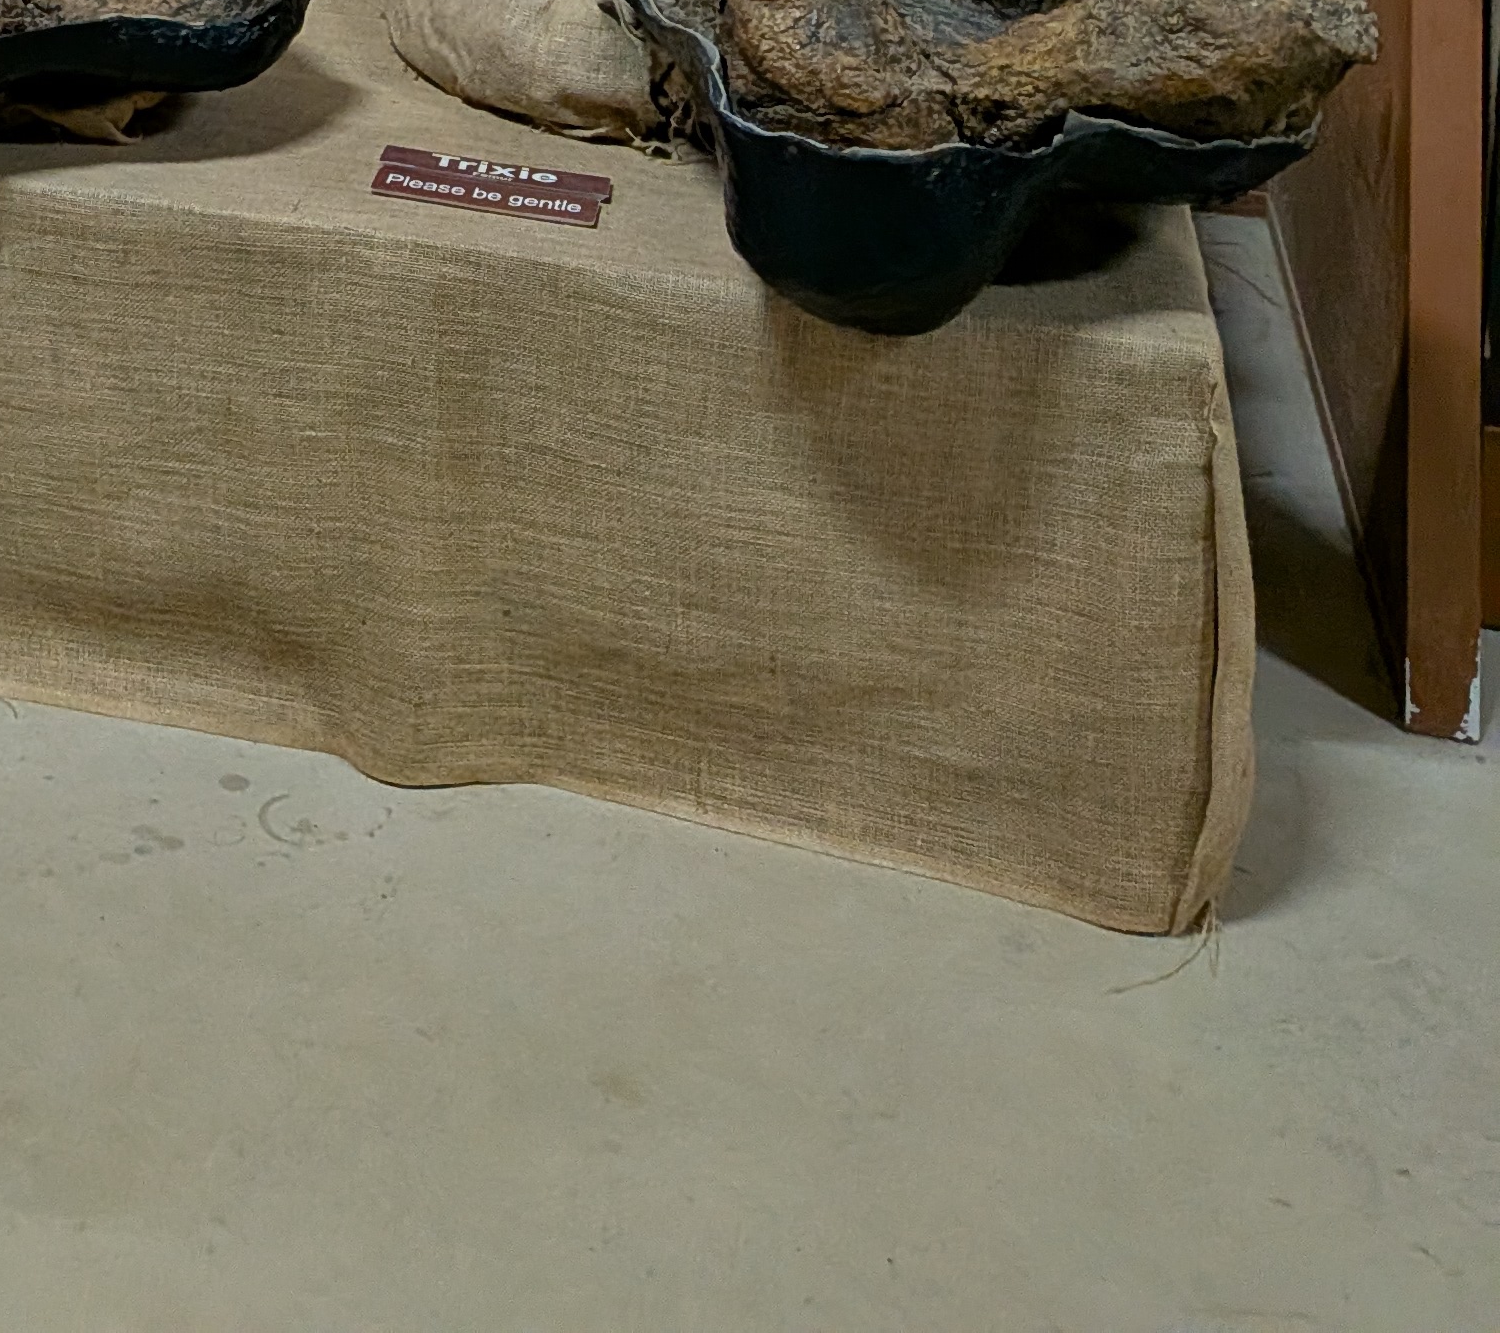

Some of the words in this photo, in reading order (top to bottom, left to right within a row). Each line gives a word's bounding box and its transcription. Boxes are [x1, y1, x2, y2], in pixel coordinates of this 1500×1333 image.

[431, 152, 558, 184] Trixie
[385, 173, 465, 196] Please
[473, 186, 501, 202] be
[509, 194, 582, 214] gentle
